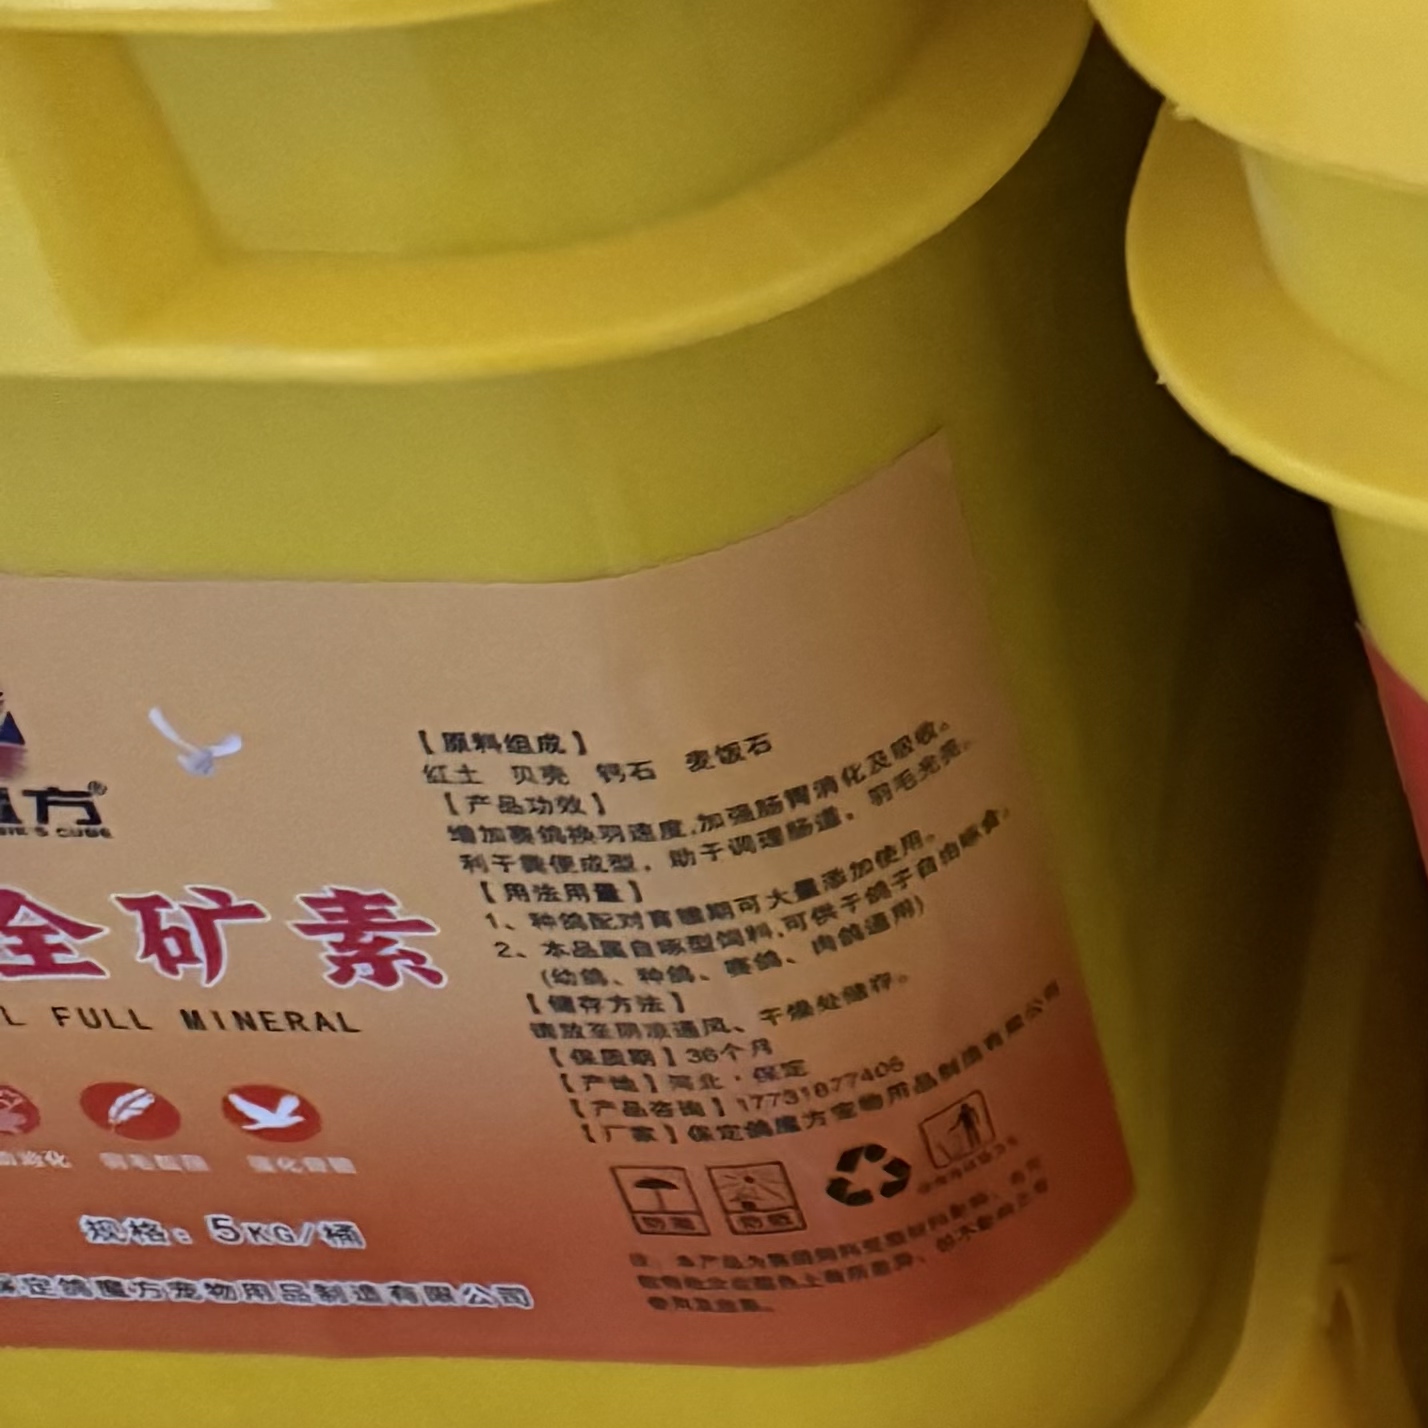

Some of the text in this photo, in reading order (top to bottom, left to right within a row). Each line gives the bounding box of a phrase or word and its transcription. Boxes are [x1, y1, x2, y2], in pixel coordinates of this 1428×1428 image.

[423, 765, 483, 784] 红土
[511, 765, 570, 785] 贝壳
[480, 880, 643, 903] 【用法用量】
[52, 1006, 153, 1030] FULL
[180, 1008, 363, 1033] MINERAL
